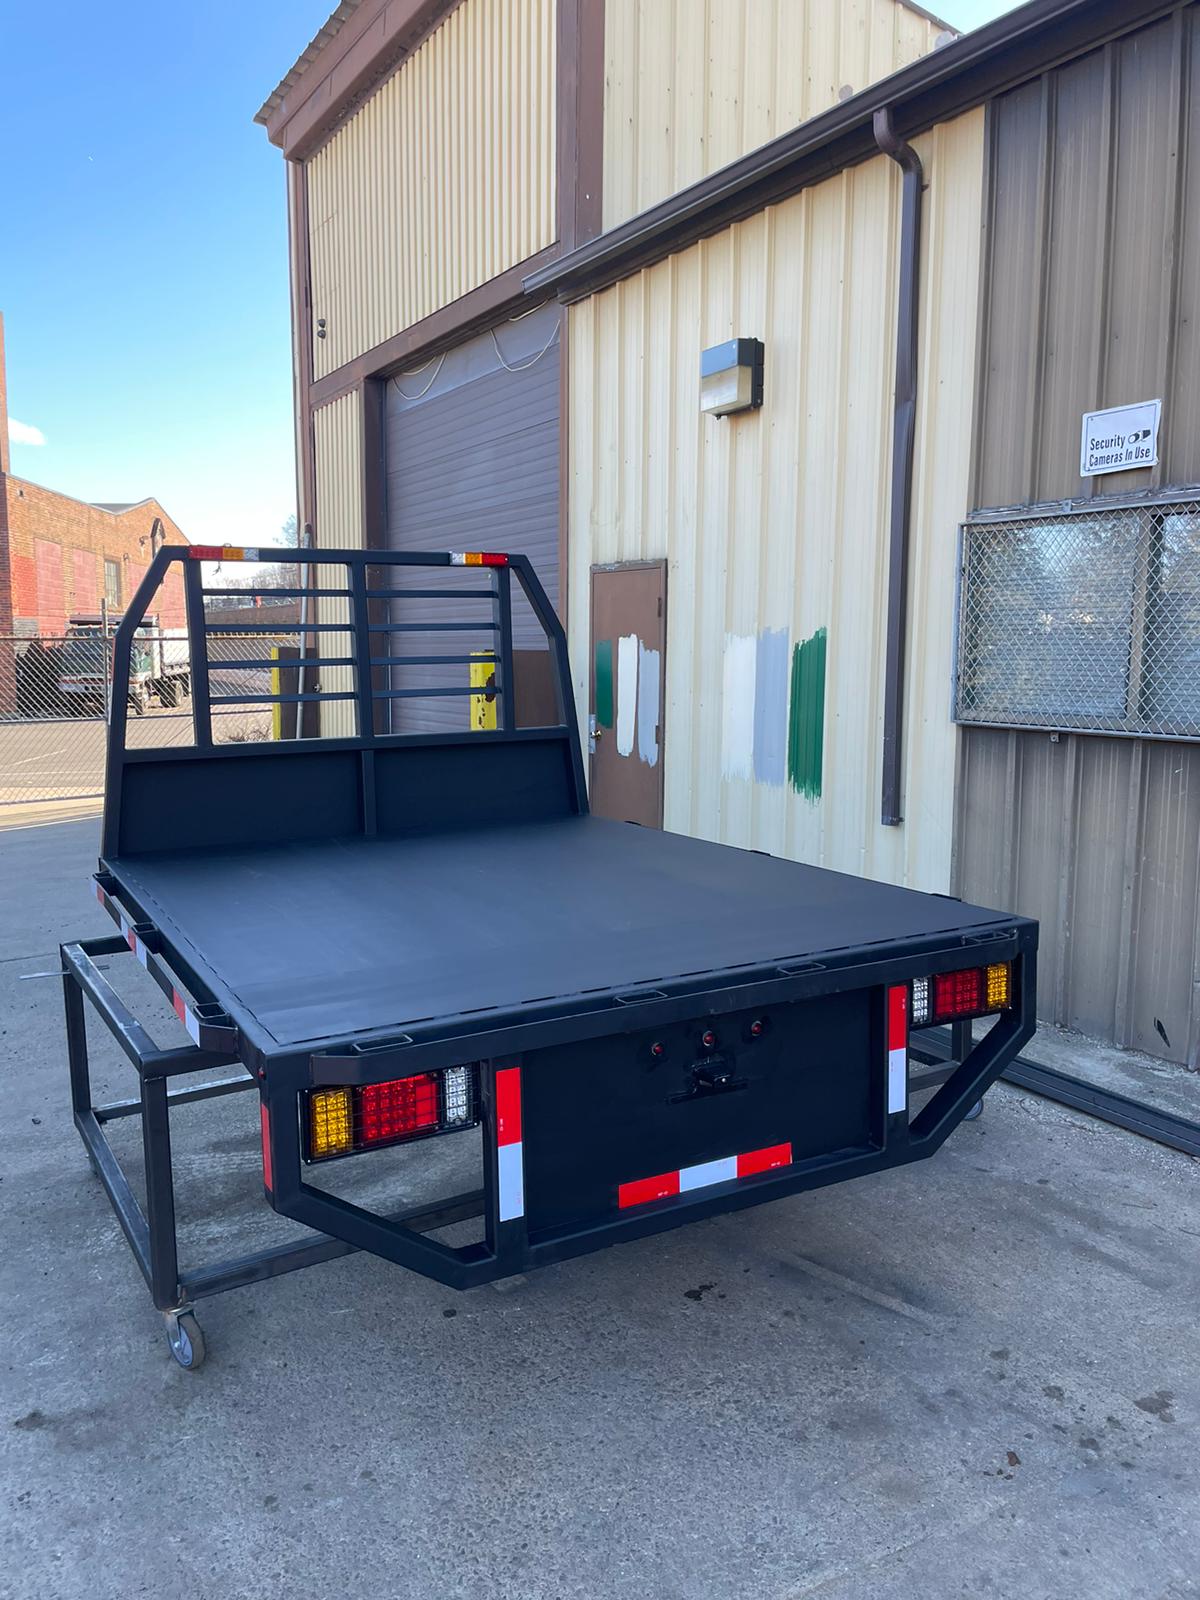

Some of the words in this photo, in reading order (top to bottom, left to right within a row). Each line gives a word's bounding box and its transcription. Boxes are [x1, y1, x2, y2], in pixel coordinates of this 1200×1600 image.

[1090, 434, 1126, 451] Security
[1089, 452, 1123, 467] Cameras
[1125, 449, 1133, 461] In
[1134, 446, 1151, 459] Use
